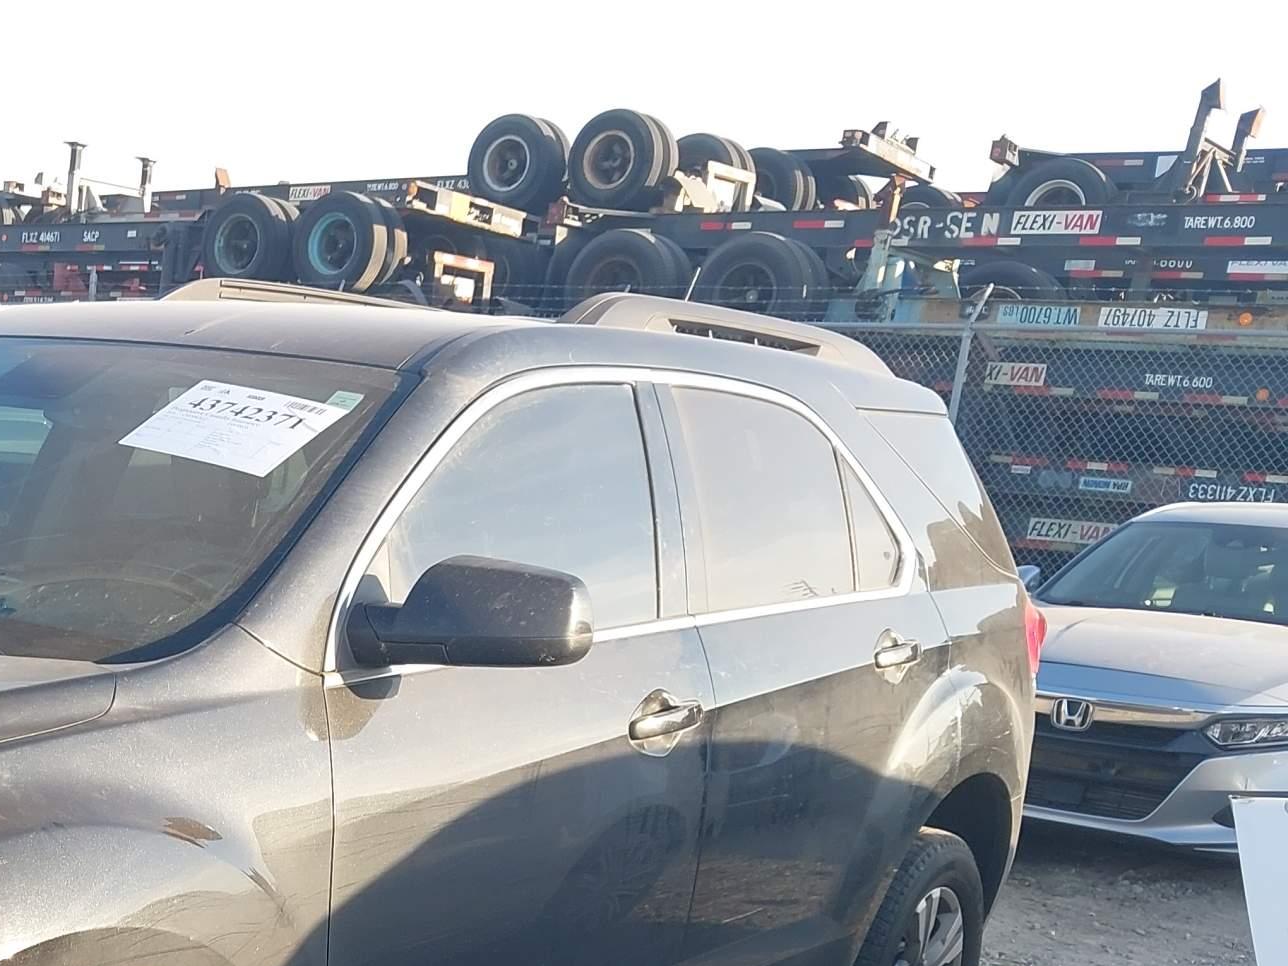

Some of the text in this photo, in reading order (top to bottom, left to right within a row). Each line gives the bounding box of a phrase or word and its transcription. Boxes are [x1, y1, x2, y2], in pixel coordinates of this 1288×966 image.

[1013, 213, 1100, 232] FLEXI-VAN
[21, 232, 38, 243] FLXZ
[82, 231, 100, 242] SACP
[1102, 307, 1201, 328] FLTZ 407497
[188, 397, 305, 430] 43742371
